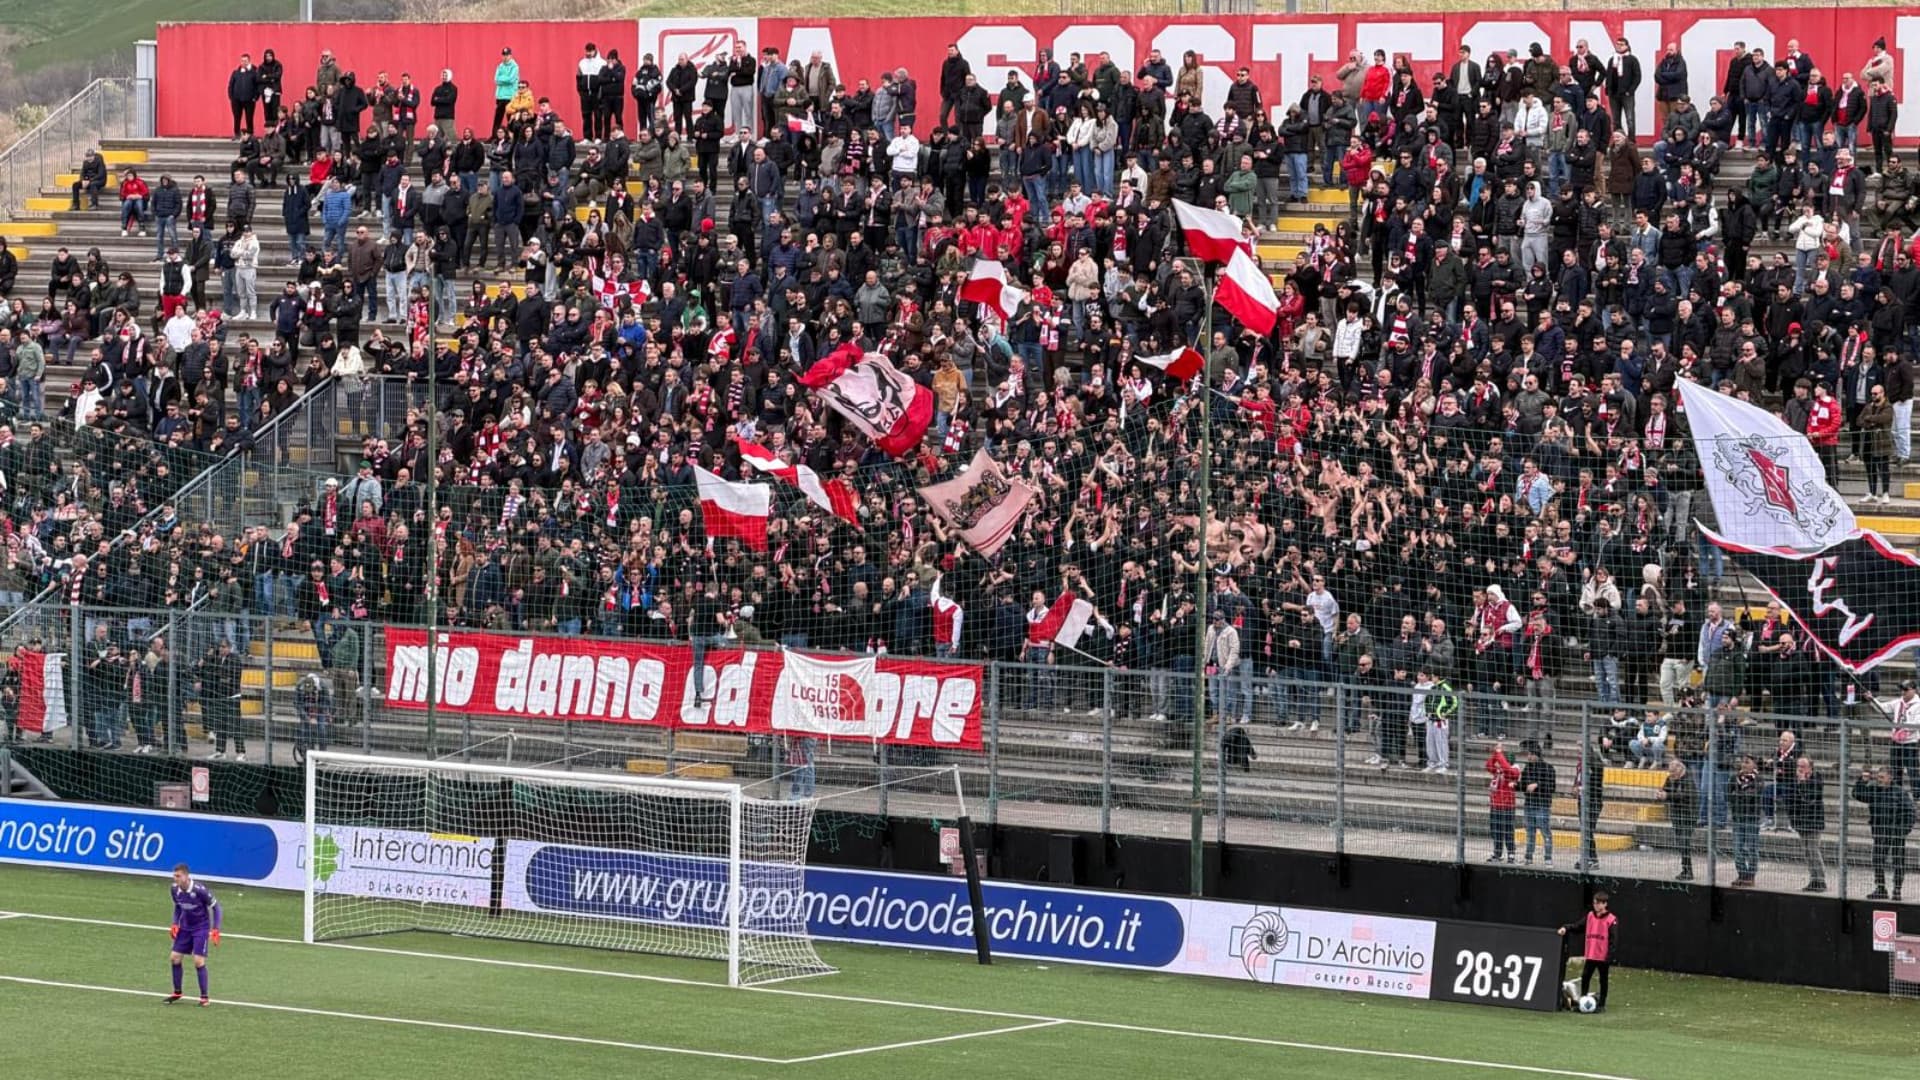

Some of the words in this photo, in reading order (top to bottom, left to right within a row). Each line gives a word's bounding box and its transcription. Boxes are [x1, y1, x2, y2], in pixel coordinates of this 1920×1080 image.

[388, 634, 479, 706] mio
[495, 639, 665, 720] danno
[680, 651, 758, 727] ed
[825, 674, 839, 688] 15
[791, 683, 839, 704] LUGLIO
[812, 704, 839, 720] 1913
[0, 817, 97, 856] nostro
[105, 821, 164, 862] sito
[368, 881, 468, 900] DIAGNOSTICA
[1307, 936, 1425, 969] D'Archivio
[1314, 973, 1360, 985] GRUPPO
[1367, 975, 1413, 991] MEDICO
[1453, 949, 1543, 1001] 28:37
